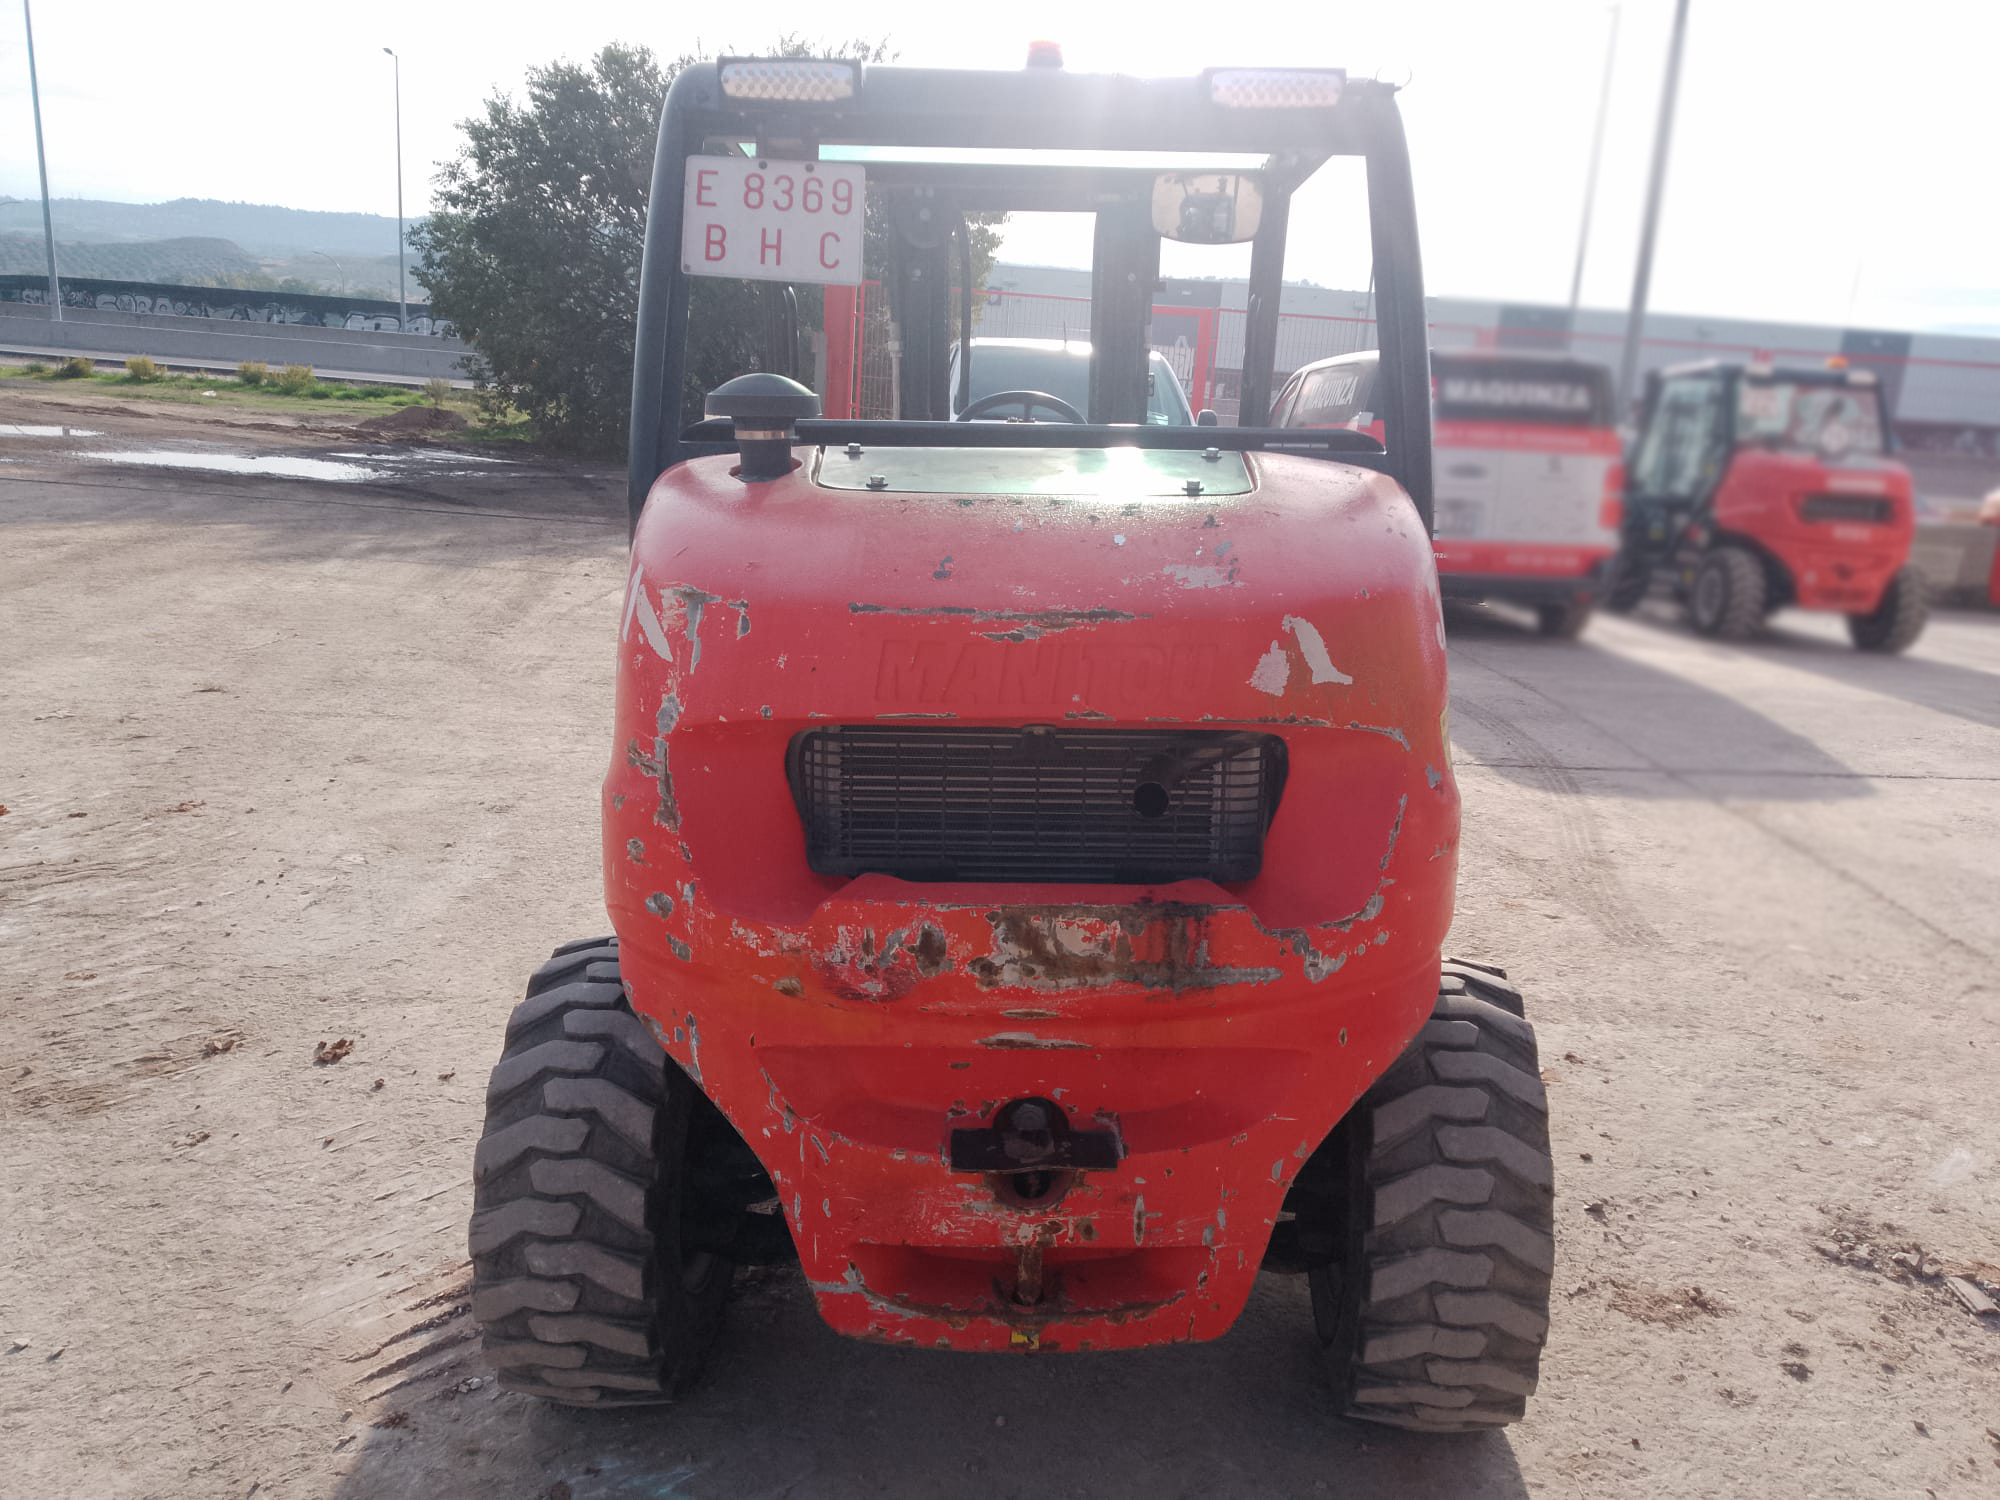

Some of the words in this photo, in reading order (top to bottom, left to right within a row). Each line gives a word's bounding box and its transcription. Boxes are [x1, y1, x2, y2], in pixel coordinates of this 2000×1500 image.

[695, 168, 720, 208] E
[742, 172, 854, 216] 8369
[1443, 378, 1592, 410] MAQUINZA
[873, 638, 1218, 706] MANITOU
